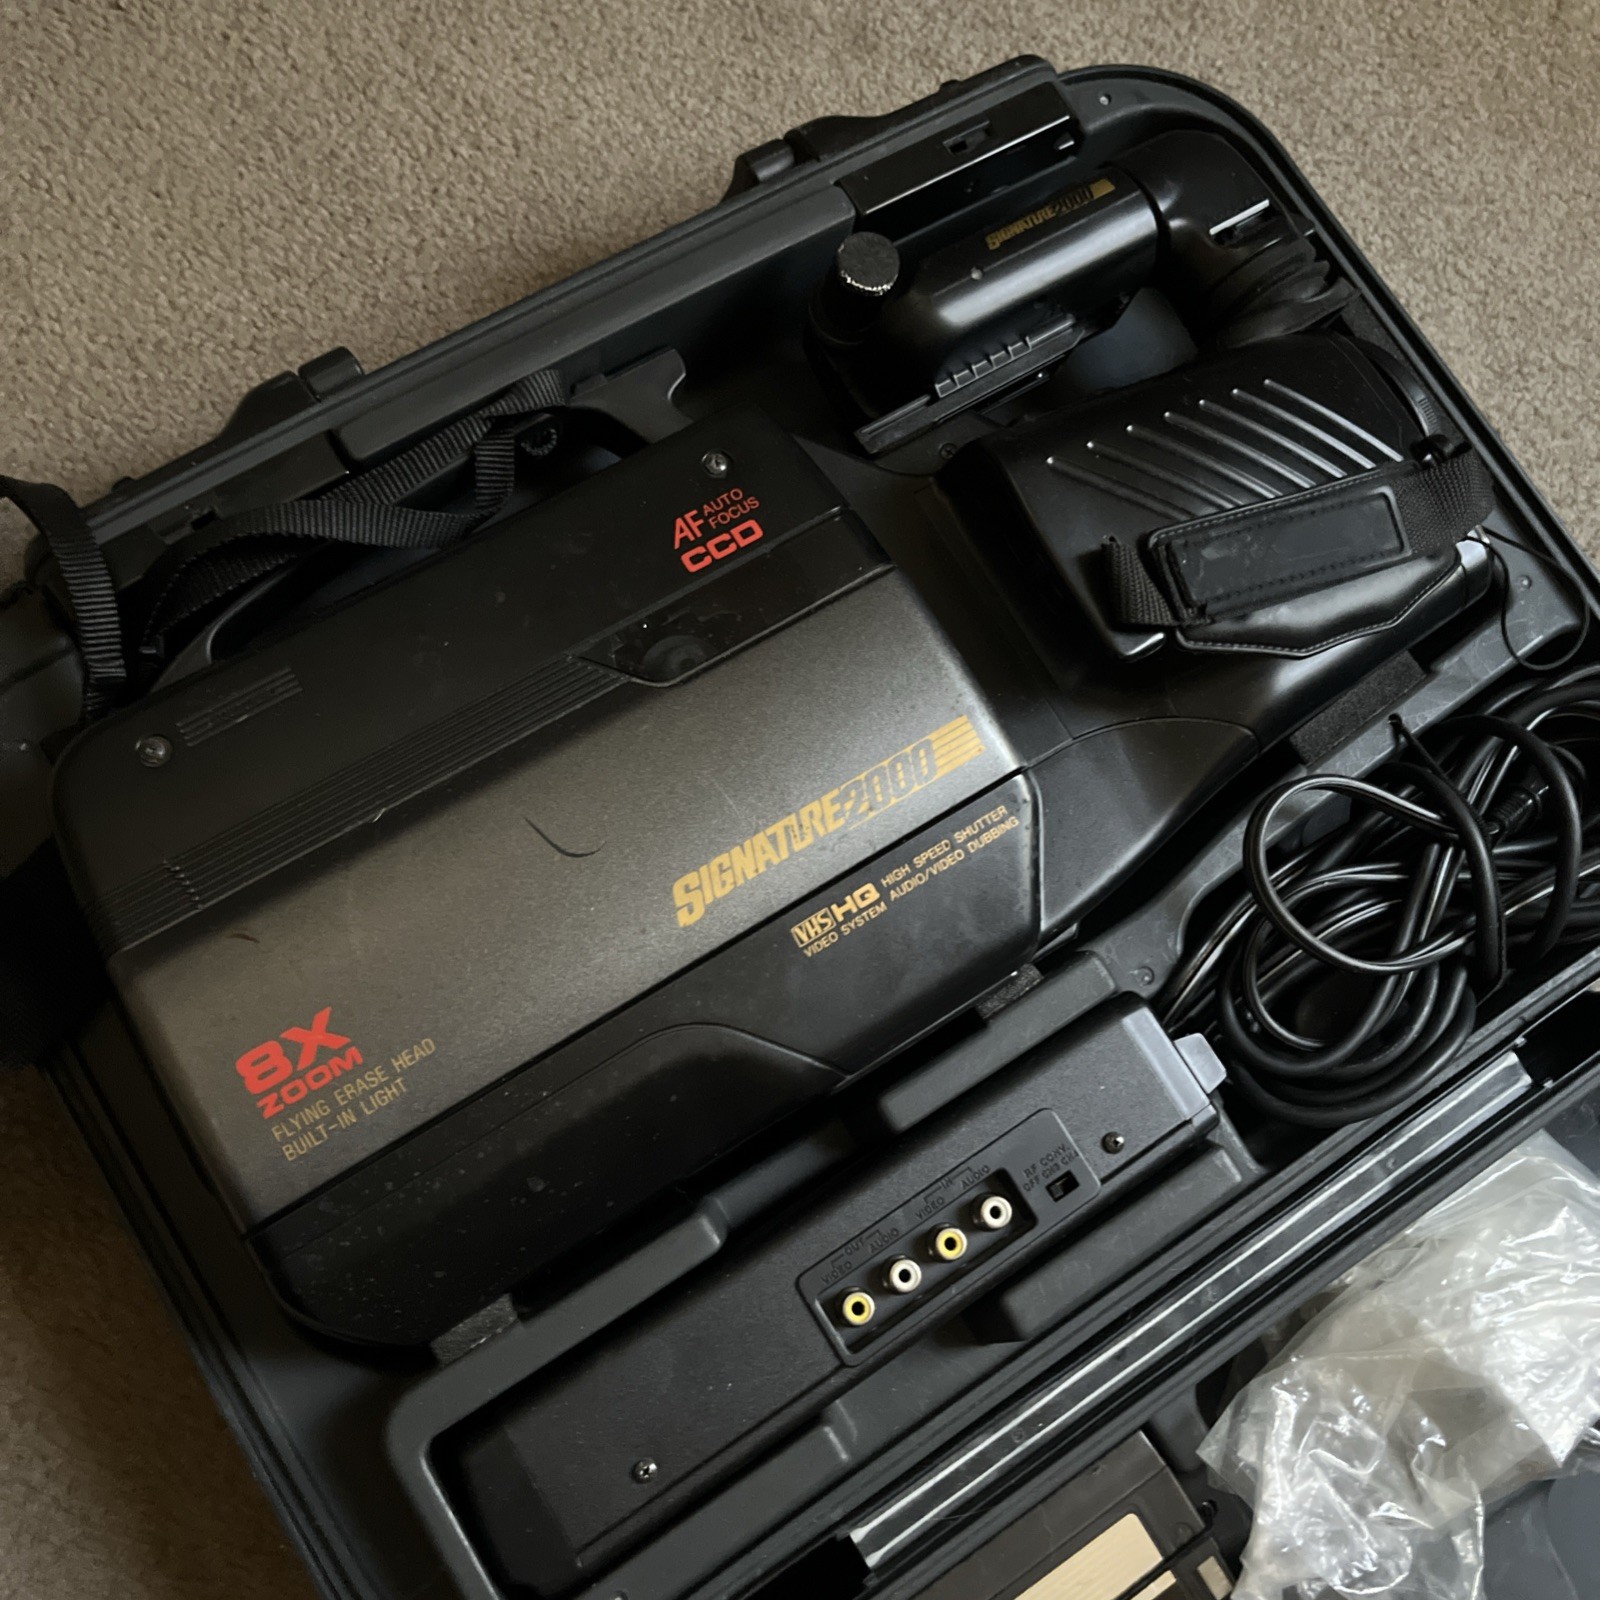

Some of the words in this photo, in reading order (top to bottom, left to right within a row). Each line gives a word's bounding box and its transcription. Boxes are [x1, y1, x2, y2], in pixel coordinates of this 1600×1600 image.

[674, 509, 704, 550] AF
[703, 488, 743, 516] AUTO
[709, 497, 760, 529] FOCUS
[681, 519, 764, 573] CCD
[881, 864, 911, 887] HIGH
[913, 839, 951, 868] SPEED
[954, 805, 1008, 843] SHUTTER
[890, 849, 965, 901] AUDIO/VIDEO
[967, 816, 1019, 853] DUBBING
[791, 907, 837, 948] VHS
[830, 882, 880, 922] HQ
[803, 931, 839, 957] VIDEO
[841, 901, 888, 935] SYSTEM
[235, 1006, 351, 1094] 8X
[256, 1046, 364, 1119] ZOOM
[272, 1099, 331, 1142] FLYING
[333, 1065, 390, 1106] ERASE
[391, 1038, 436, 1073] HEAD
[282, 1108, 357, 1161] BUILT-IN
[359, 1077, 408, 1115] LIGHT
[914, 1196, 945, 1219] VIDEO
[961, 1164, 991, 1190] AUDIO
[1023, 1163, 1037, 1178] RF
[1023, 1175, 1040, 1192] OFF
[821, 1261, 852, 1285] VIDEO
[869, 1227, 900, 1254] AUDIO
